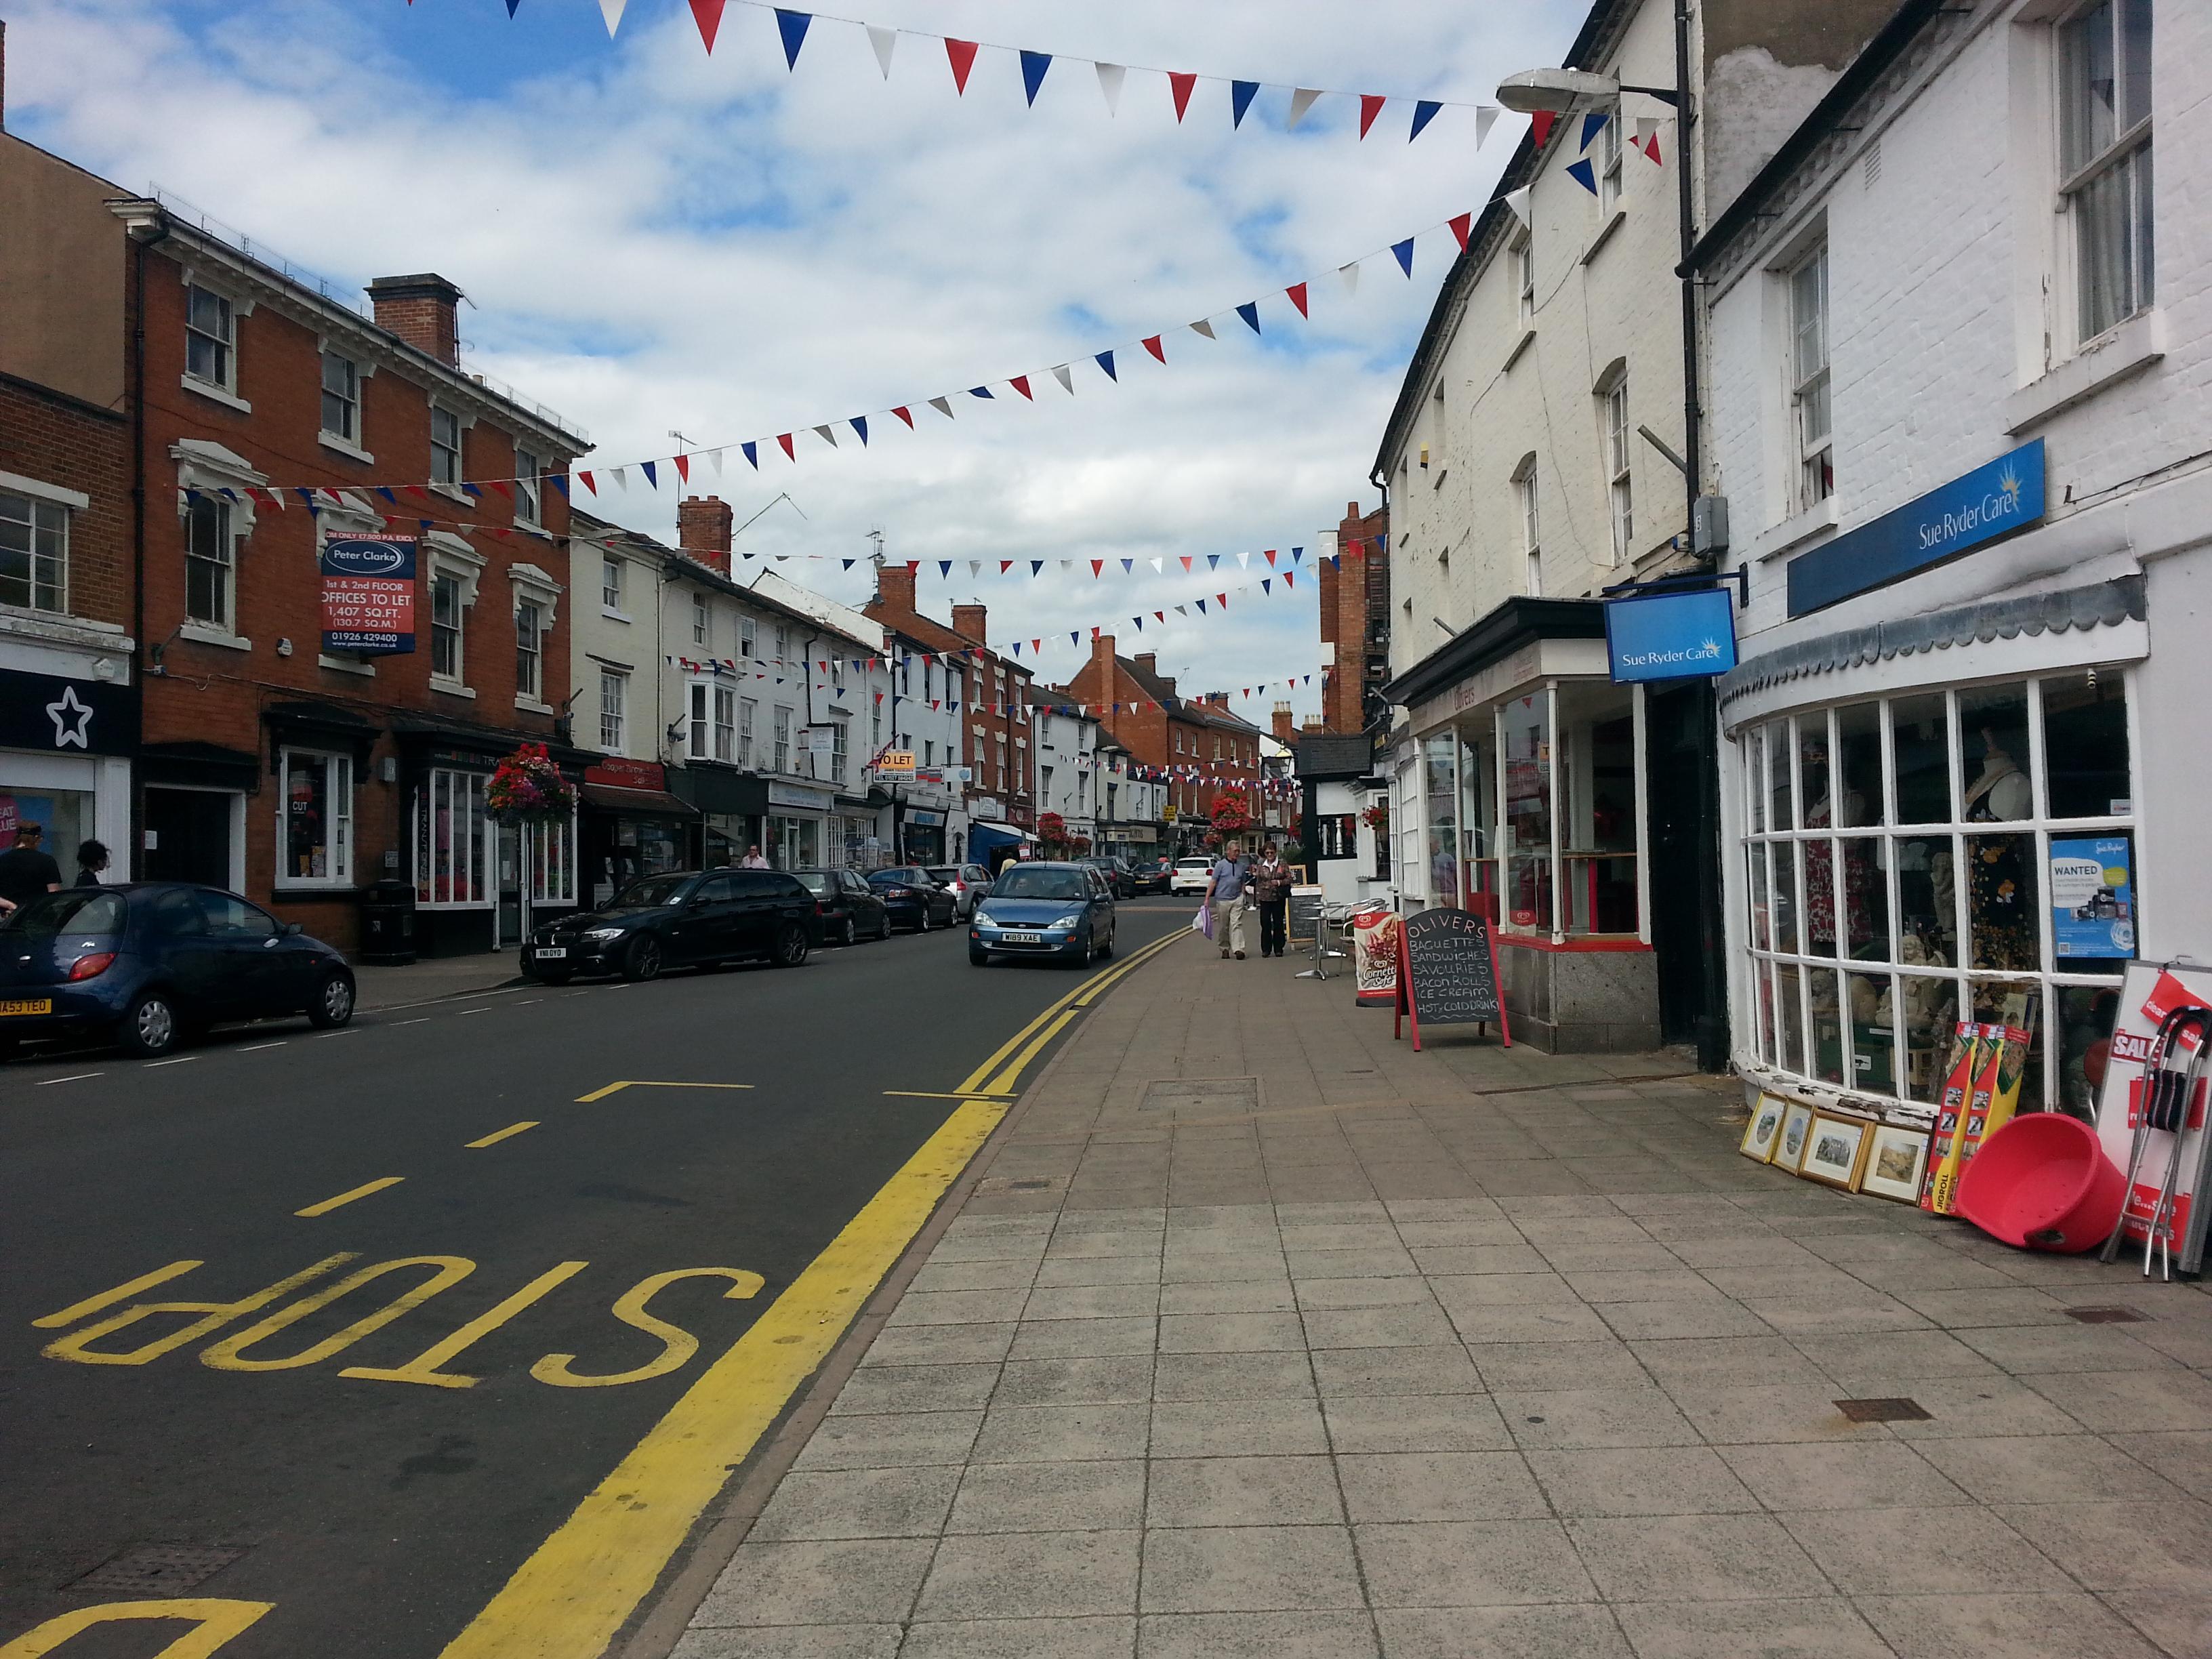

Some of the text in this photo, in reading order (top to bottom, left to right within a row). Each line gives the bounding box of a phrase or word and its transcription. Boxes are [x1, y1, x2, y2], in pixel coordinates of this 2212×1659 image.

[1920, 493, 2012, 550] Sue Ryder Care
[334, 550, 396, 562] Peter Clarke
[327, 580, 403, 592] 1st & 2nd FLOOR
[371, 594, 388, 605] TO
[392, 595, 411, 607] LET
[329, 607, 401, 619] 1,407 SQ.FT.
[333, 618, 396, 629] (130.7 SQ.M.)
[332, 632, 397, 642] 01926 429400
[1622, 648, 1714, 666] Sue Ryder Care
[894, 756, 912, 765] LET
[293, 801, 308, 811] CUT
[2055, 865, 2097, 876] WANTED
[1408, 915, 1486, 939] OLIVERS
[1410, 937, 1485, 951] BAGUETTES
[1410, 949, 1489, 963] SANDWICHES
[1363, 966, 1397, 981] Cornett
[1413, 961, 1488, 975] SAVOURIES
[1372, 976, 1393, 987] Soft
[1414, 975, 1491, 988] BACON ROLLS
[1415, 987, 1489, 999] ICE CREAM
[0, 1000, 46, 1013] A53 TEO
[1417, 1003, 1439, 1014] HOT
[2182, 1029, 2200, 1044] sal
[1937, 1174, 1949, 1210] JIGROLL
[41, 1251, 765, 1389] STOP
